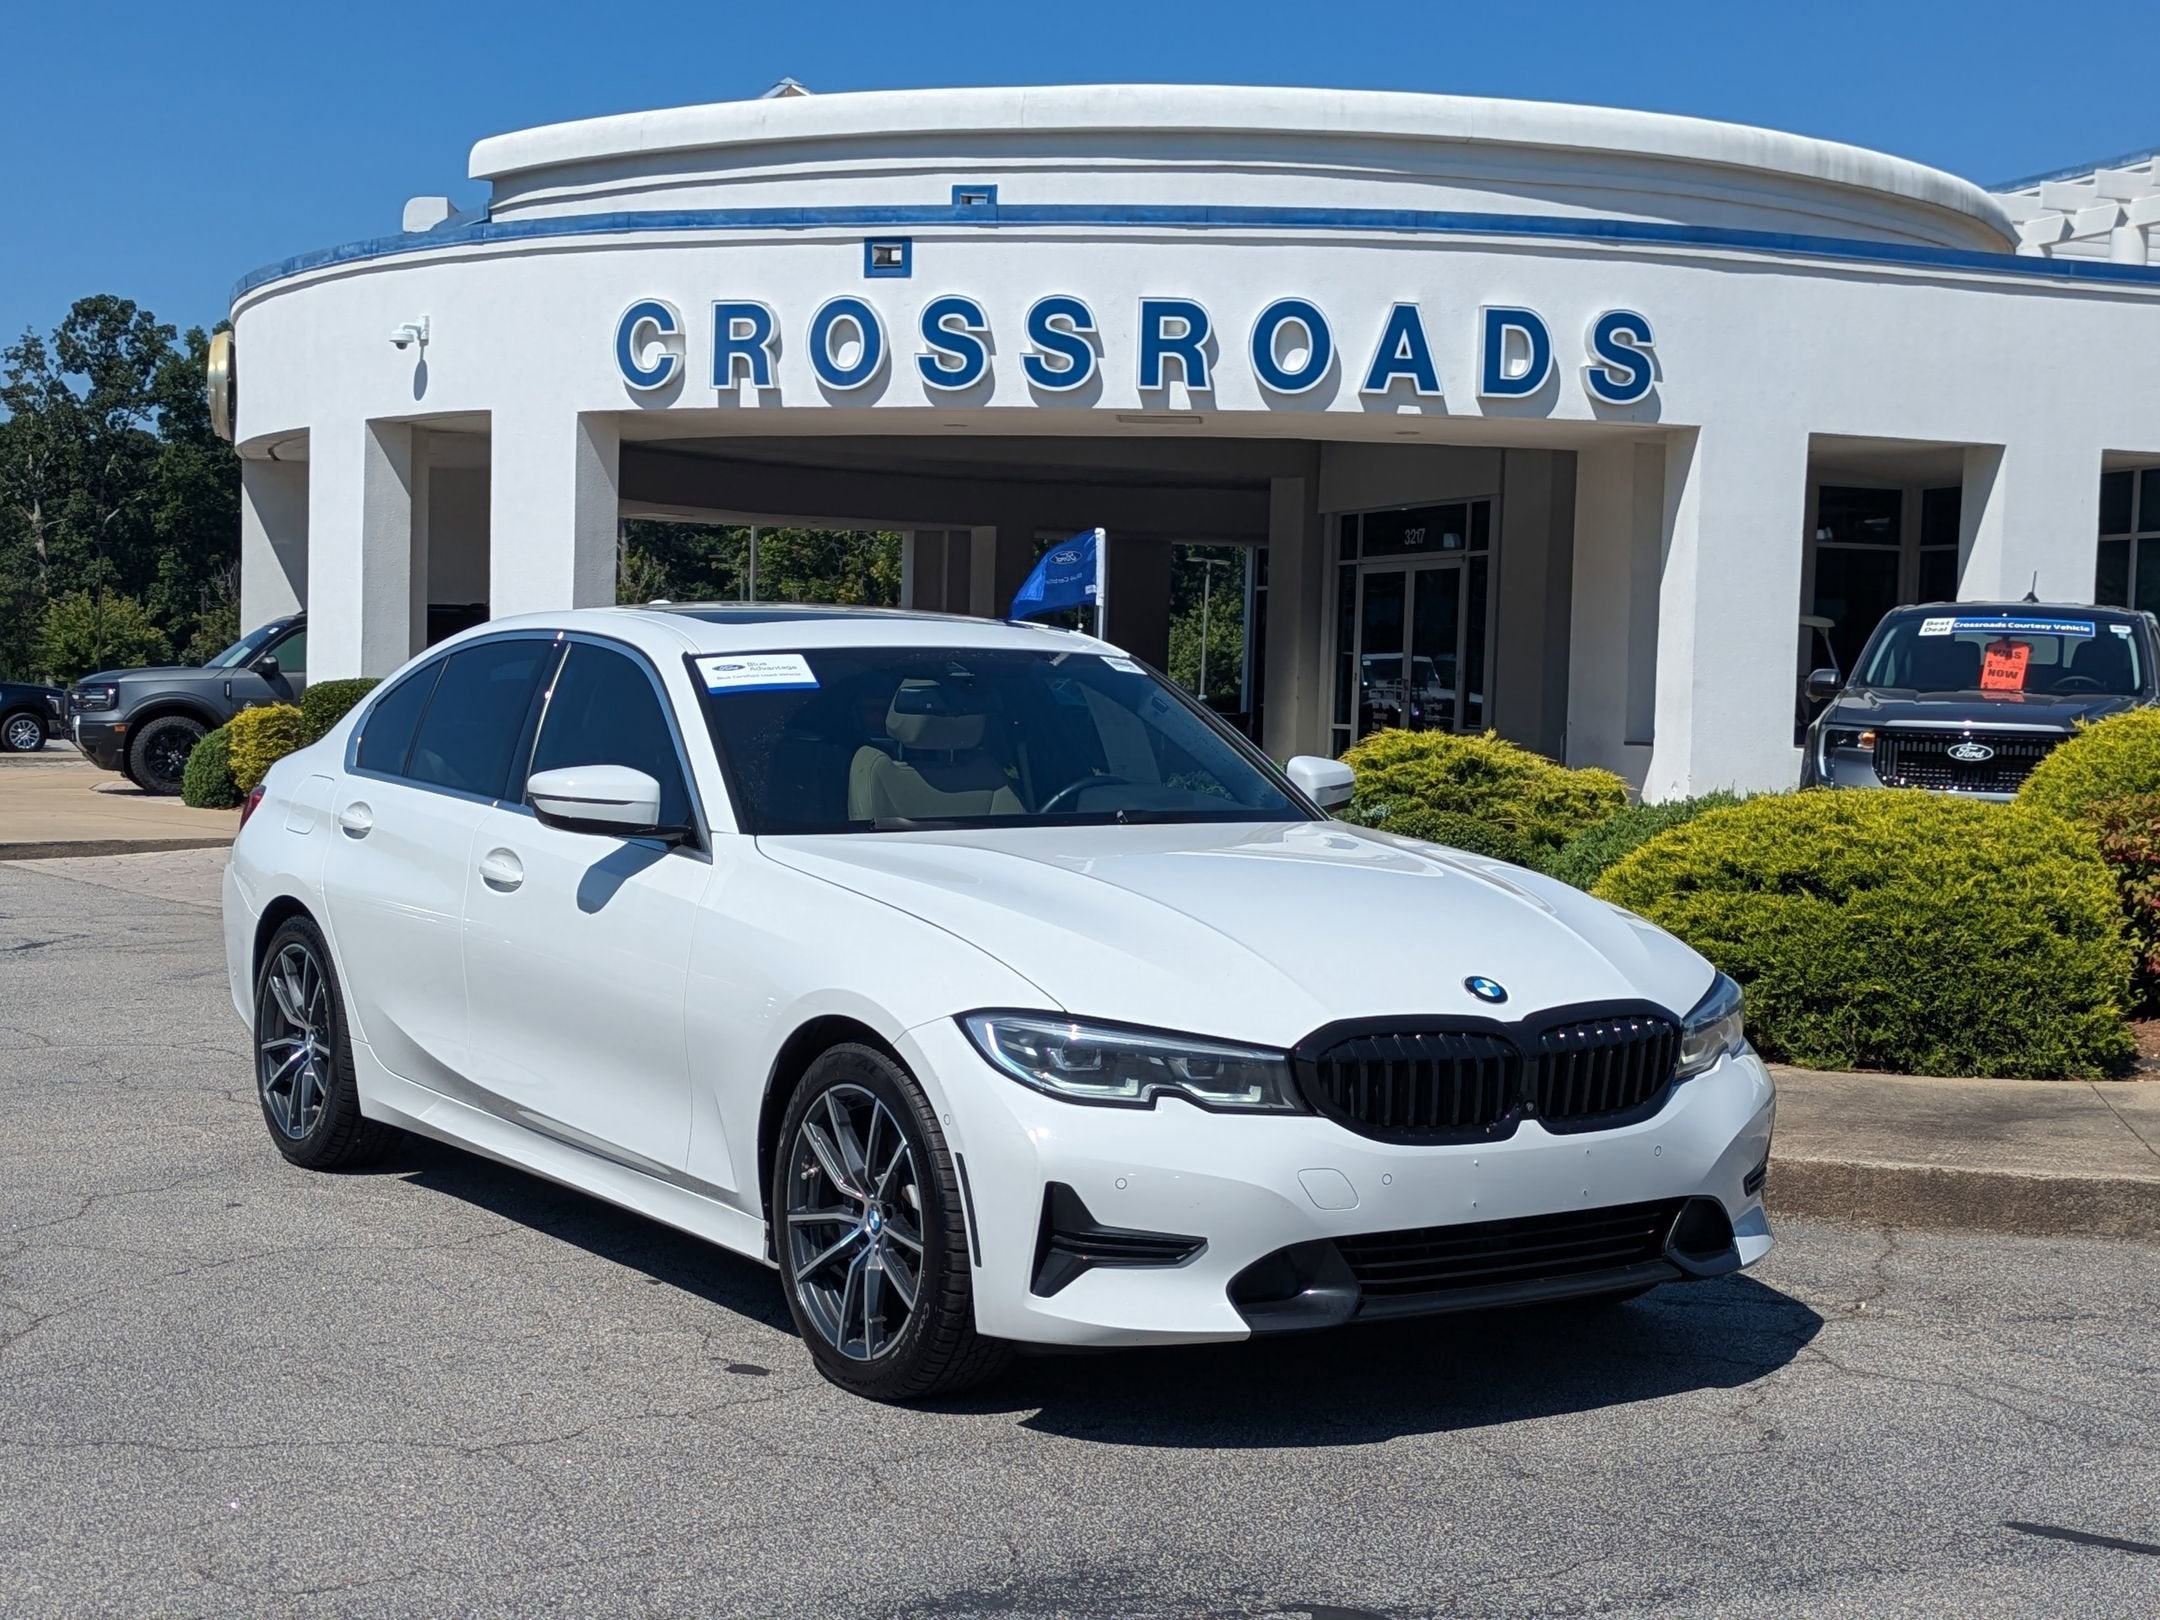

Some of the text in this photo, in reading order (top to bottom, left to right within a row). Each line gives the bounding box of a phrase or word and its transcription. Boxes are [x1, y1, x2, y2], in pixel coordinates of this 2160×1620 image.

[613, 294, 1656, 404] CROSSROADS
[1404, 527, 1426, 545] 3217
[2007, 622, 2052, 630] Courtesy
[2053, 624, 2091, 632] Vehicle
[1987, 669, 2019, 680] NOW
[1956, 746, 1986, 758] Ford
